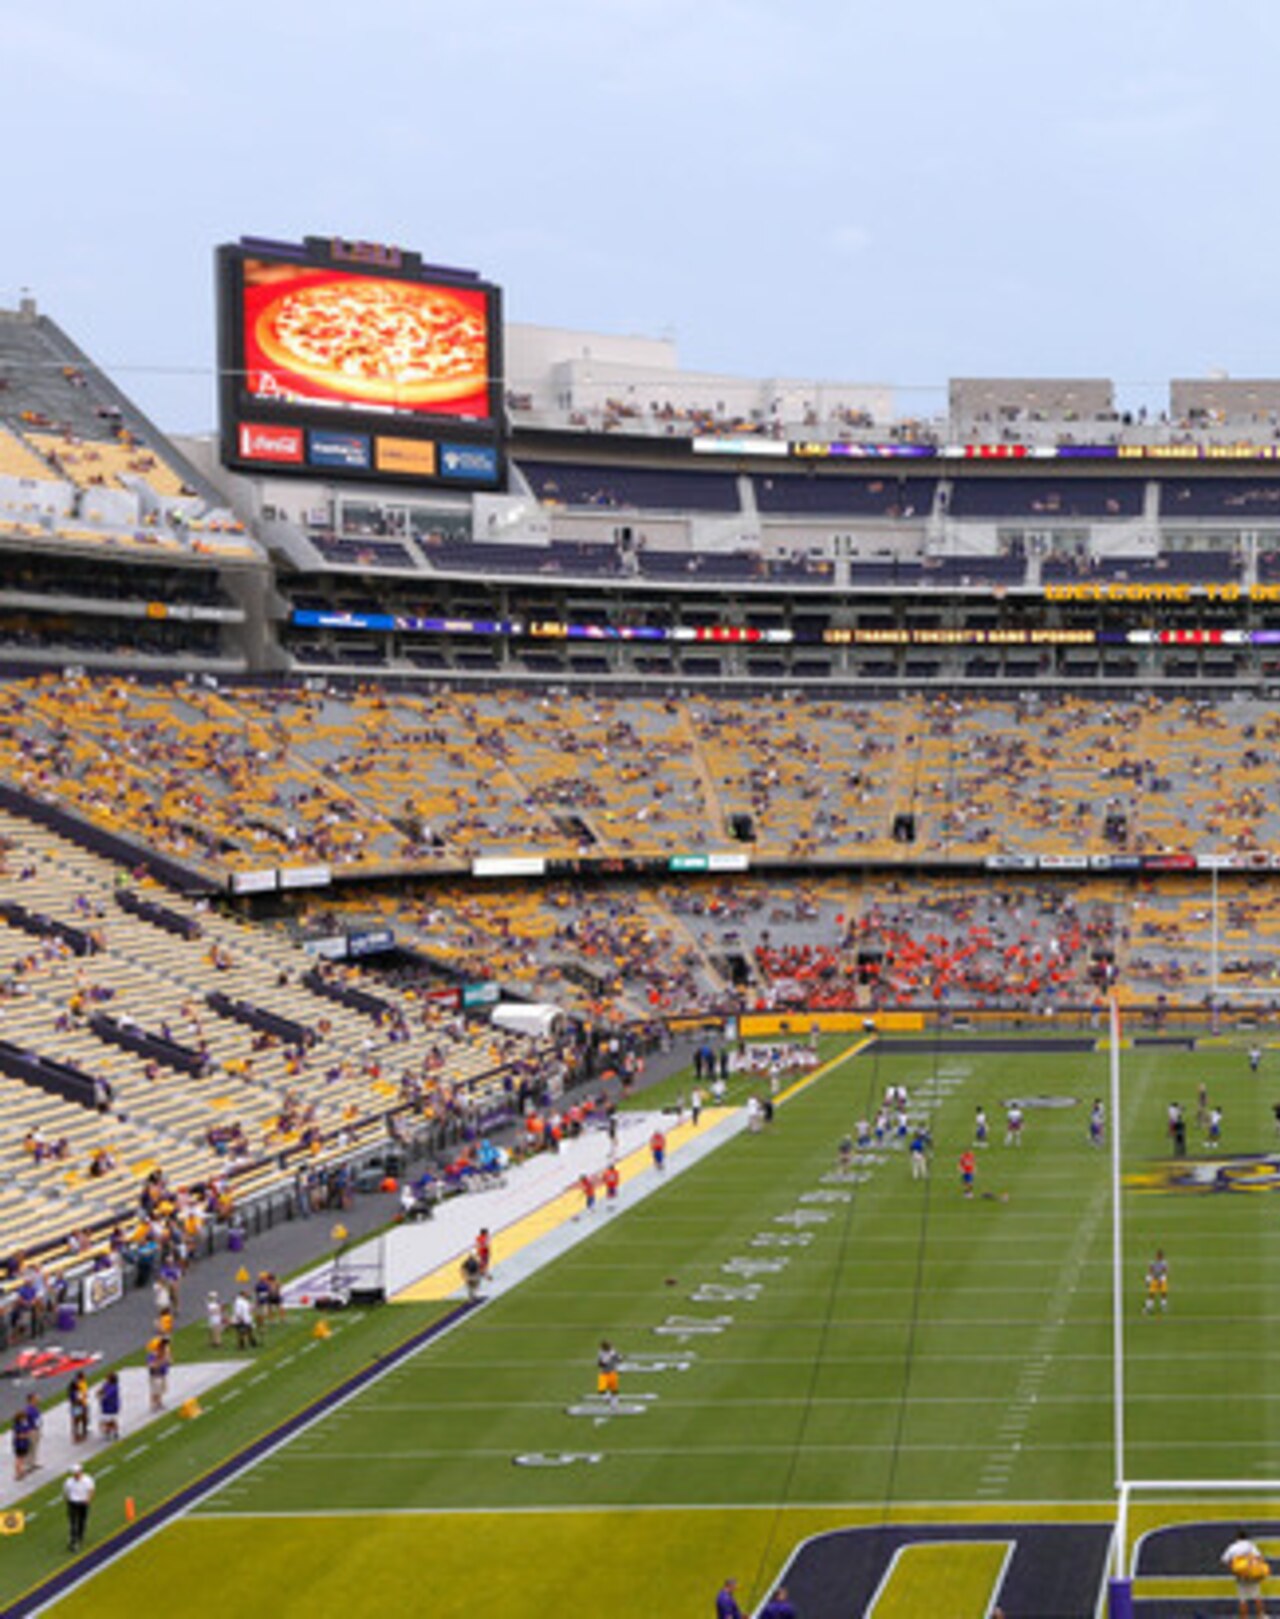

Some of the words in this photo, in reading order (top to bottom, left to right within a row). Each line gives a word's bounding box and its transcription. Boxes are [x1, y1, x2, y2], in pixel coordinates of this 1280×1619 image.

[331, 237, 401, 268] LSU
[1044, 583, 1190, 602] WELCOME
[1206, 583, 1239, 602] TO
[653, 1315, 733, 1334] 20
[513, 1453, 603, 1467] 5
